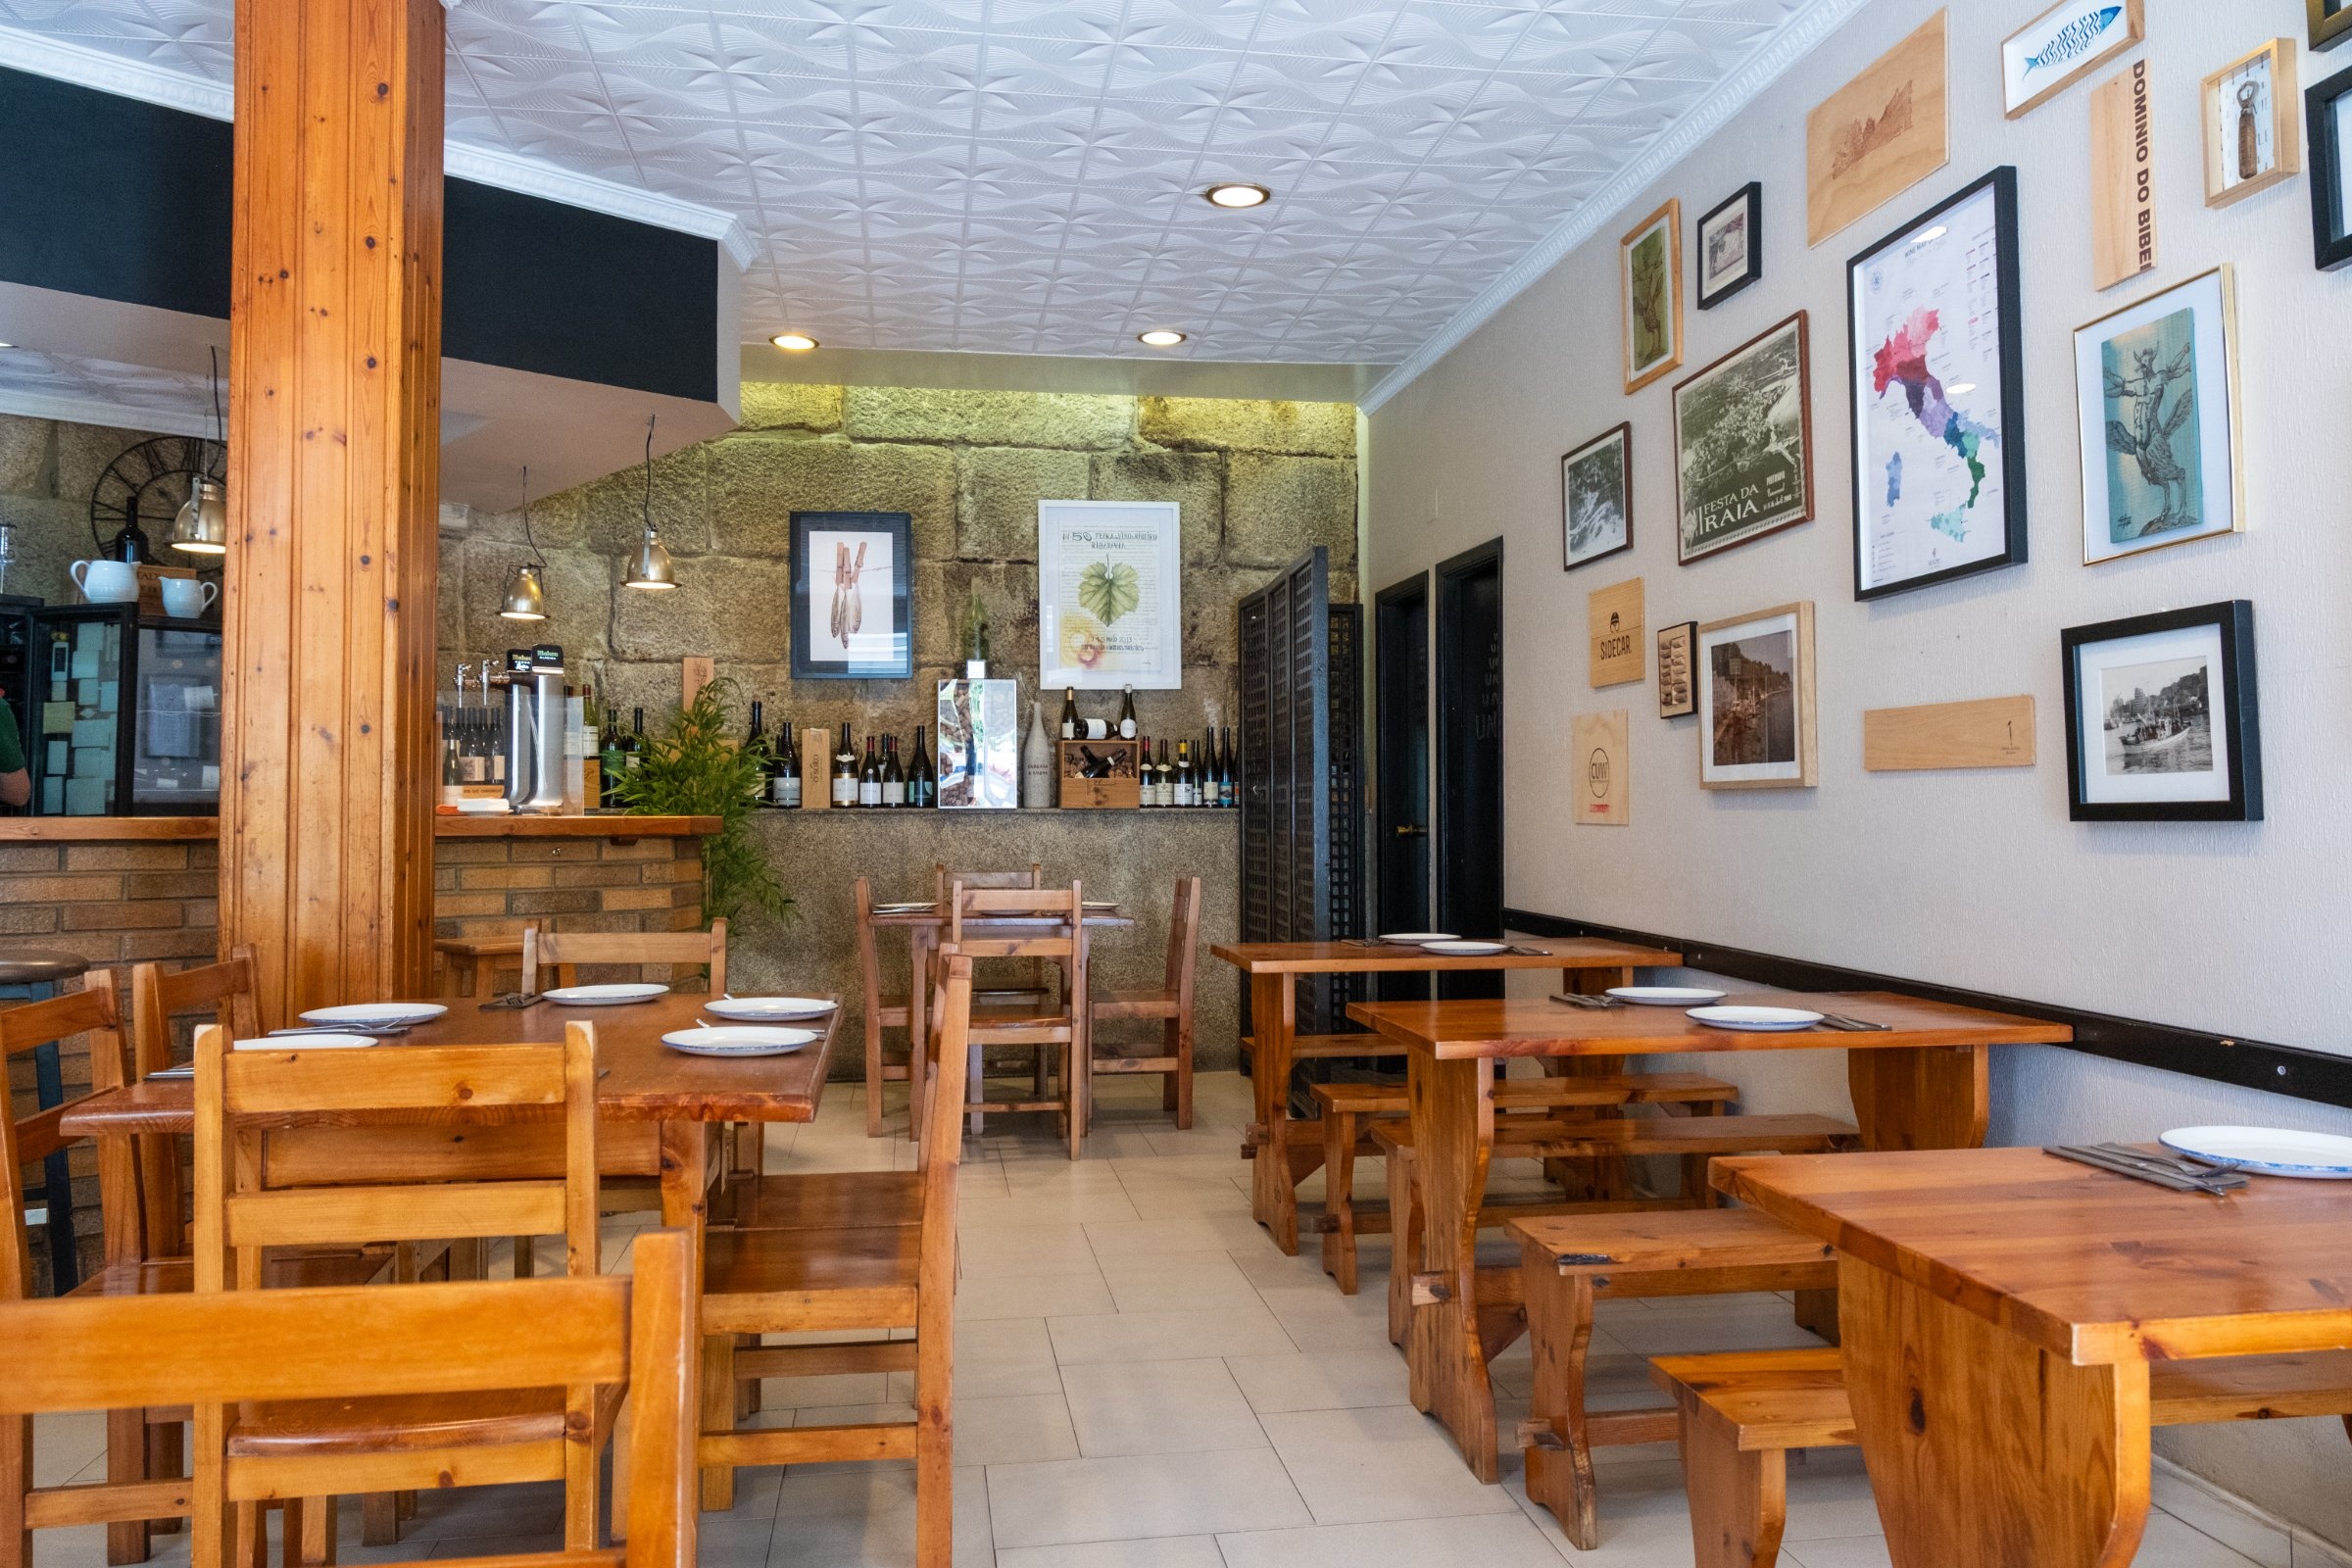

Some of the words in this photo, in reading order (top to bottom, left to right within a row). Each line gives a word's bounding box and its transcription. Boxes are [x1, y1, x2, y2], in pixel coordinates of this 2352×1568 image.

[2133, 59, 2149, 163] DOMINIO
[2137, 168, 2150, 203] DO
[1704, 492, 1739, 514] FESTA
[1740, 483, 1760, 500] DA
[1704, 499, 1761, 533] RAIA
[1600, 635, 1632, 661] SIDECAR
